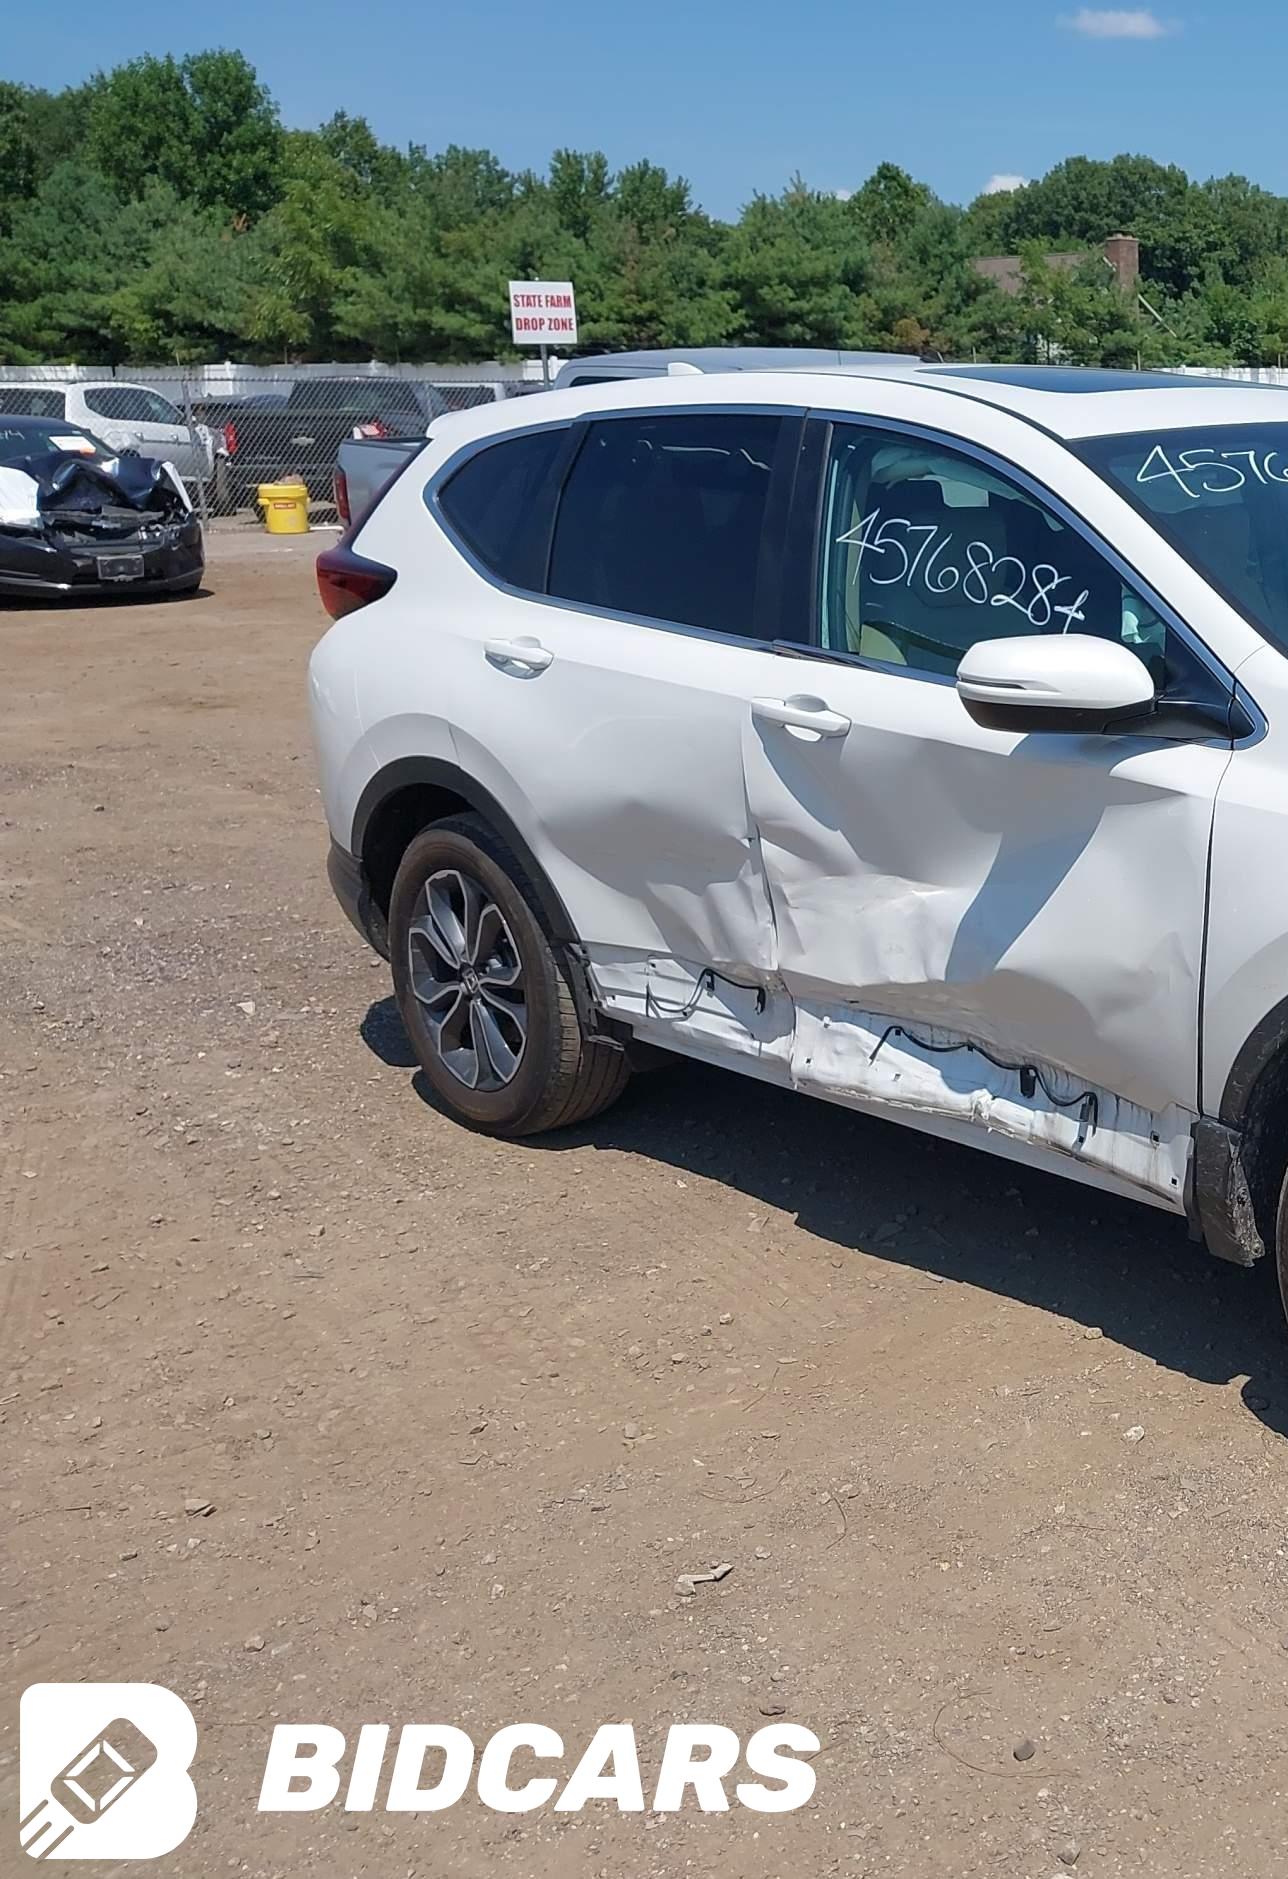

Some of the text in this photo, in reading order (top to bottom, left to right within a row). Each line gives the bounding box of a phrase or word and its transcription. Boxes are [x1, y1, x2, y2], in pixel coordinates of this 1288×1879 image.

[513, 294, 572, 308] STATE FARM
[515, 317, 574, 331] DROP ZONE
[835, 506, 1090, 635] 45768284
